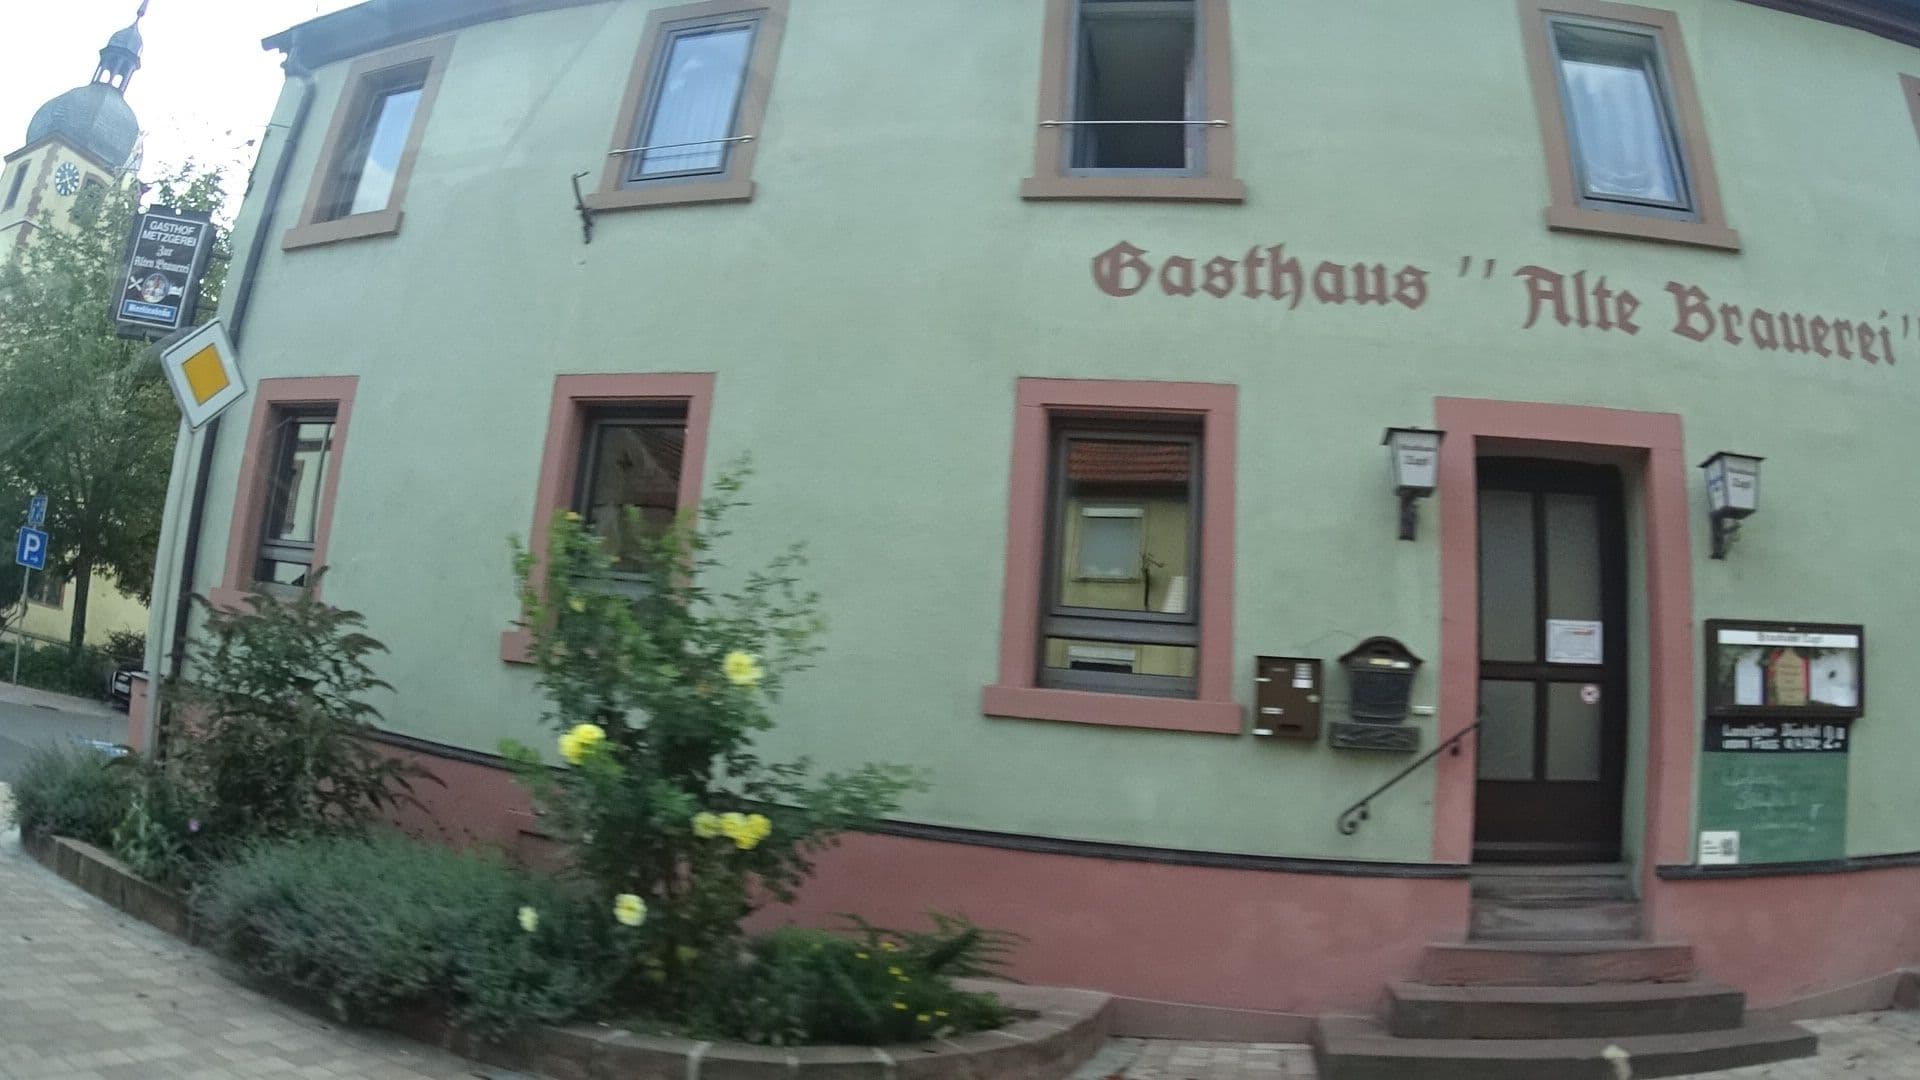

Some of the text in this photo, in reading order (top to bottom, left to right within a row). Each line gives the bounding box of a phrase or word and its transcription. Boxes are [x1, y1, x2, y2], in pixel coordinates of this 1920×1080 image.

[141, 230, 197, 247] METZGEREI
[149, 220, 195, 235] GASTHOF
[1092, 240, 1430, 310] Gasthaus
[23, 533, 41, 561] P
